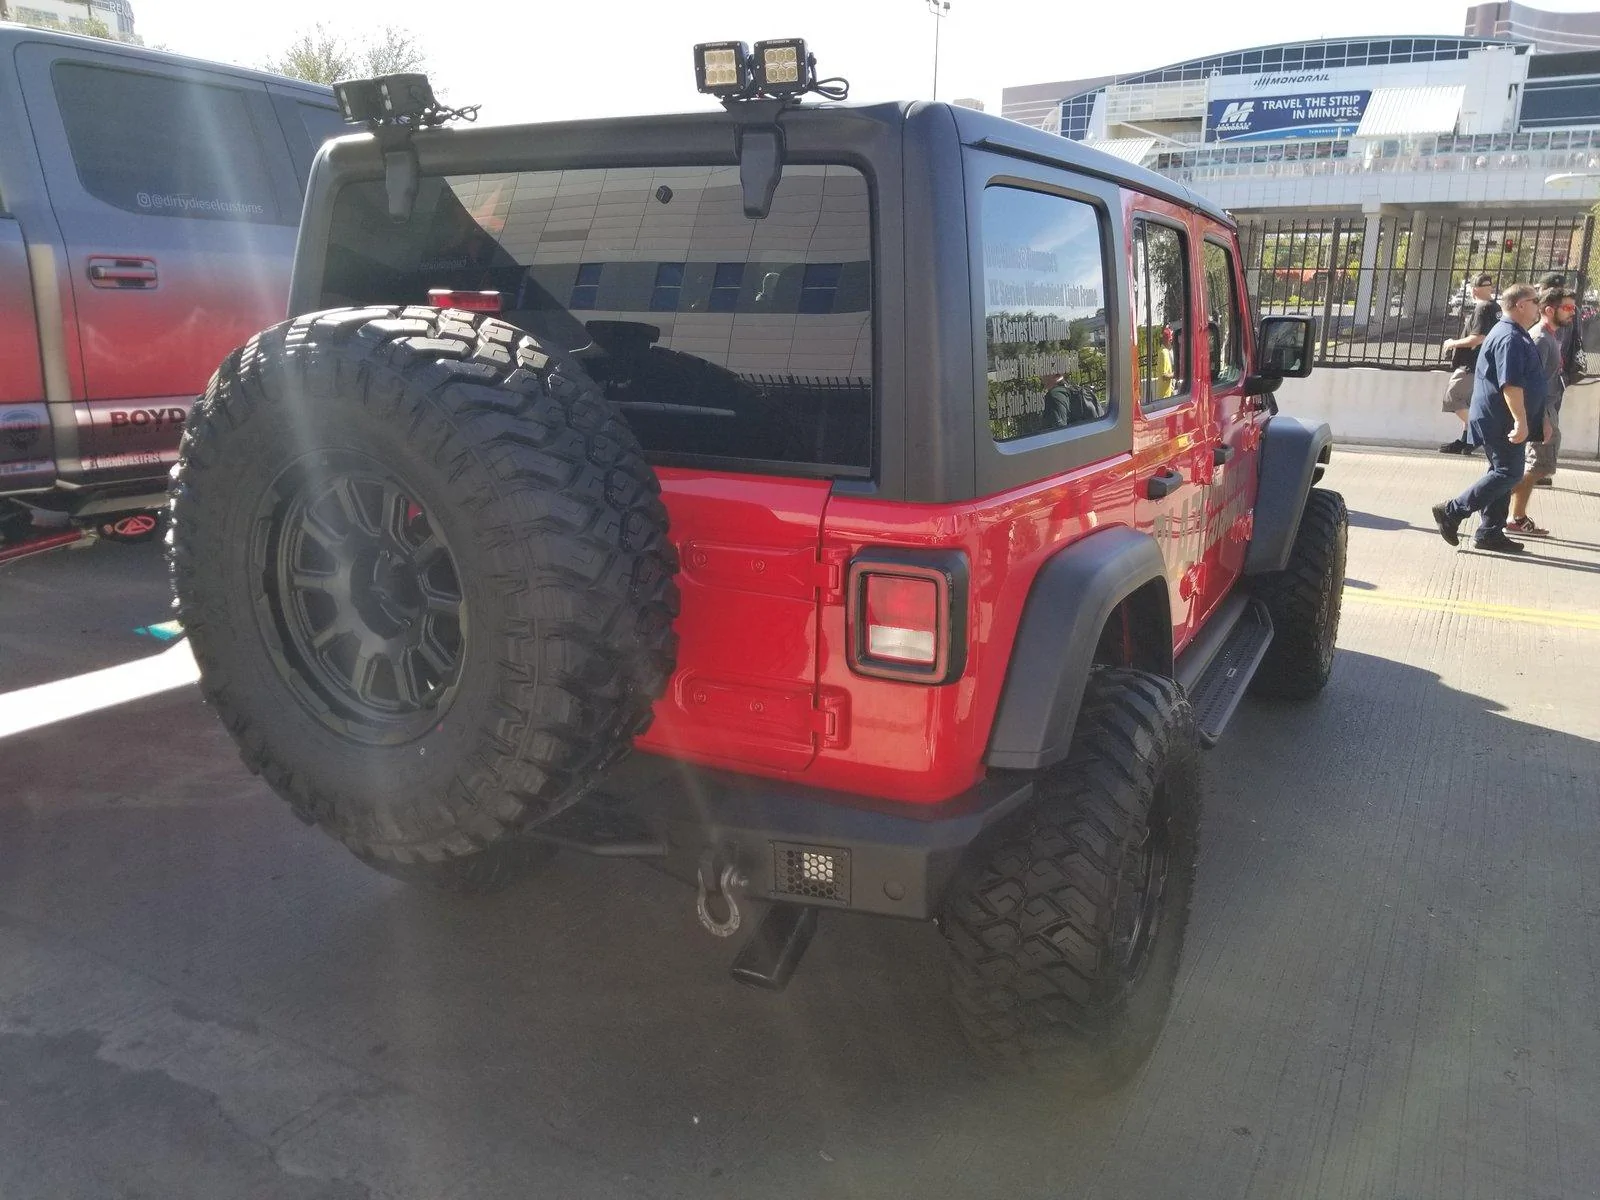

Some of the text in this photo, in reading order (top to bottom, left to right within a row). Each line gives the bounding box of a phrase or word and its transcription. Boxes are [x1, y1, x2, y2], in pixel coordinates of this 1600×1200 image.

[1271, 74, 1330, 85] MONORAIL
[1262, 95, 1360, 110] TRAVEL THE STRIP
[1292, 106, 1362, 120] IN MINUTES.
[1003, 317, 1028, 343] Series
[1028, 317, 1046, 345] Light
[110, 408, 186, 426] BOYD
